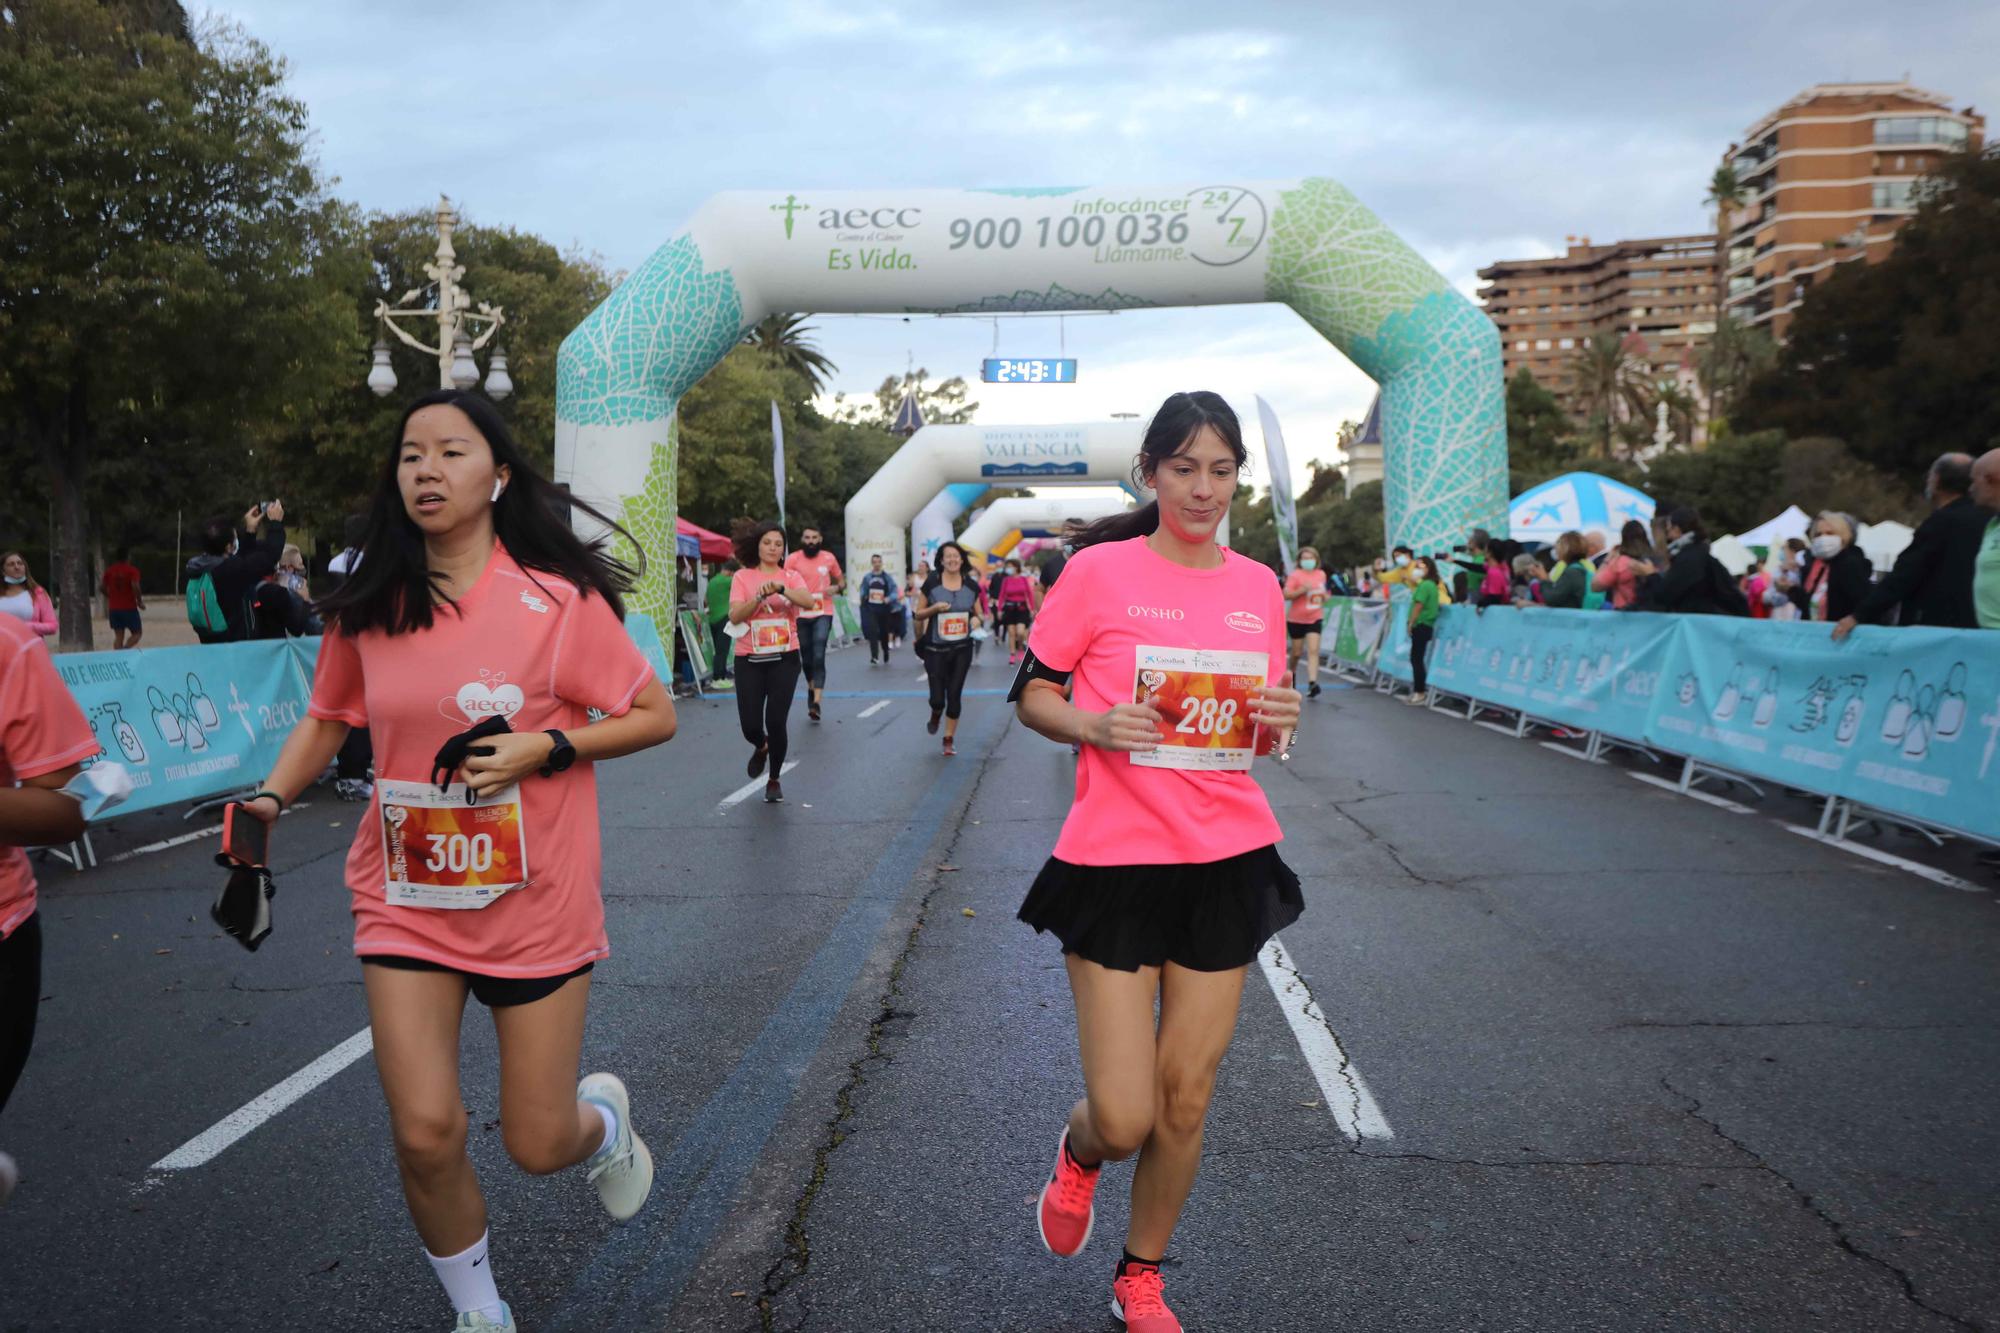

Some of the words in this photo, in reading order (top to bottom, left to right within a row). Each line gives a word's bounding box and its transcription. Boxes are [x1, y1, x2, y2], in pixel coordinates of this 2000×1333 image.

[1073, 198, 1191, 214] infocáncer
[1203, 191, 1229, 204] 24
[818, 208, 921, 229] aecc
[949, 217, 1021, 250] 900
[1036, 215, 1105, 247] 100
[1116, 212, 1189, 246] 036
[1228, 217, 1246, 244] 7
[828, 248, 852, 270] Es
[859, 247, 918, 270] Vida.
[1128, 605, 1185, 621] OYSHO
[88, 661, 135, 684] HIGIENE
[464, 699, 518, 712] aecc
[1175, 696, 1237, 735] 288
[426, 833, 492, 872] 300
